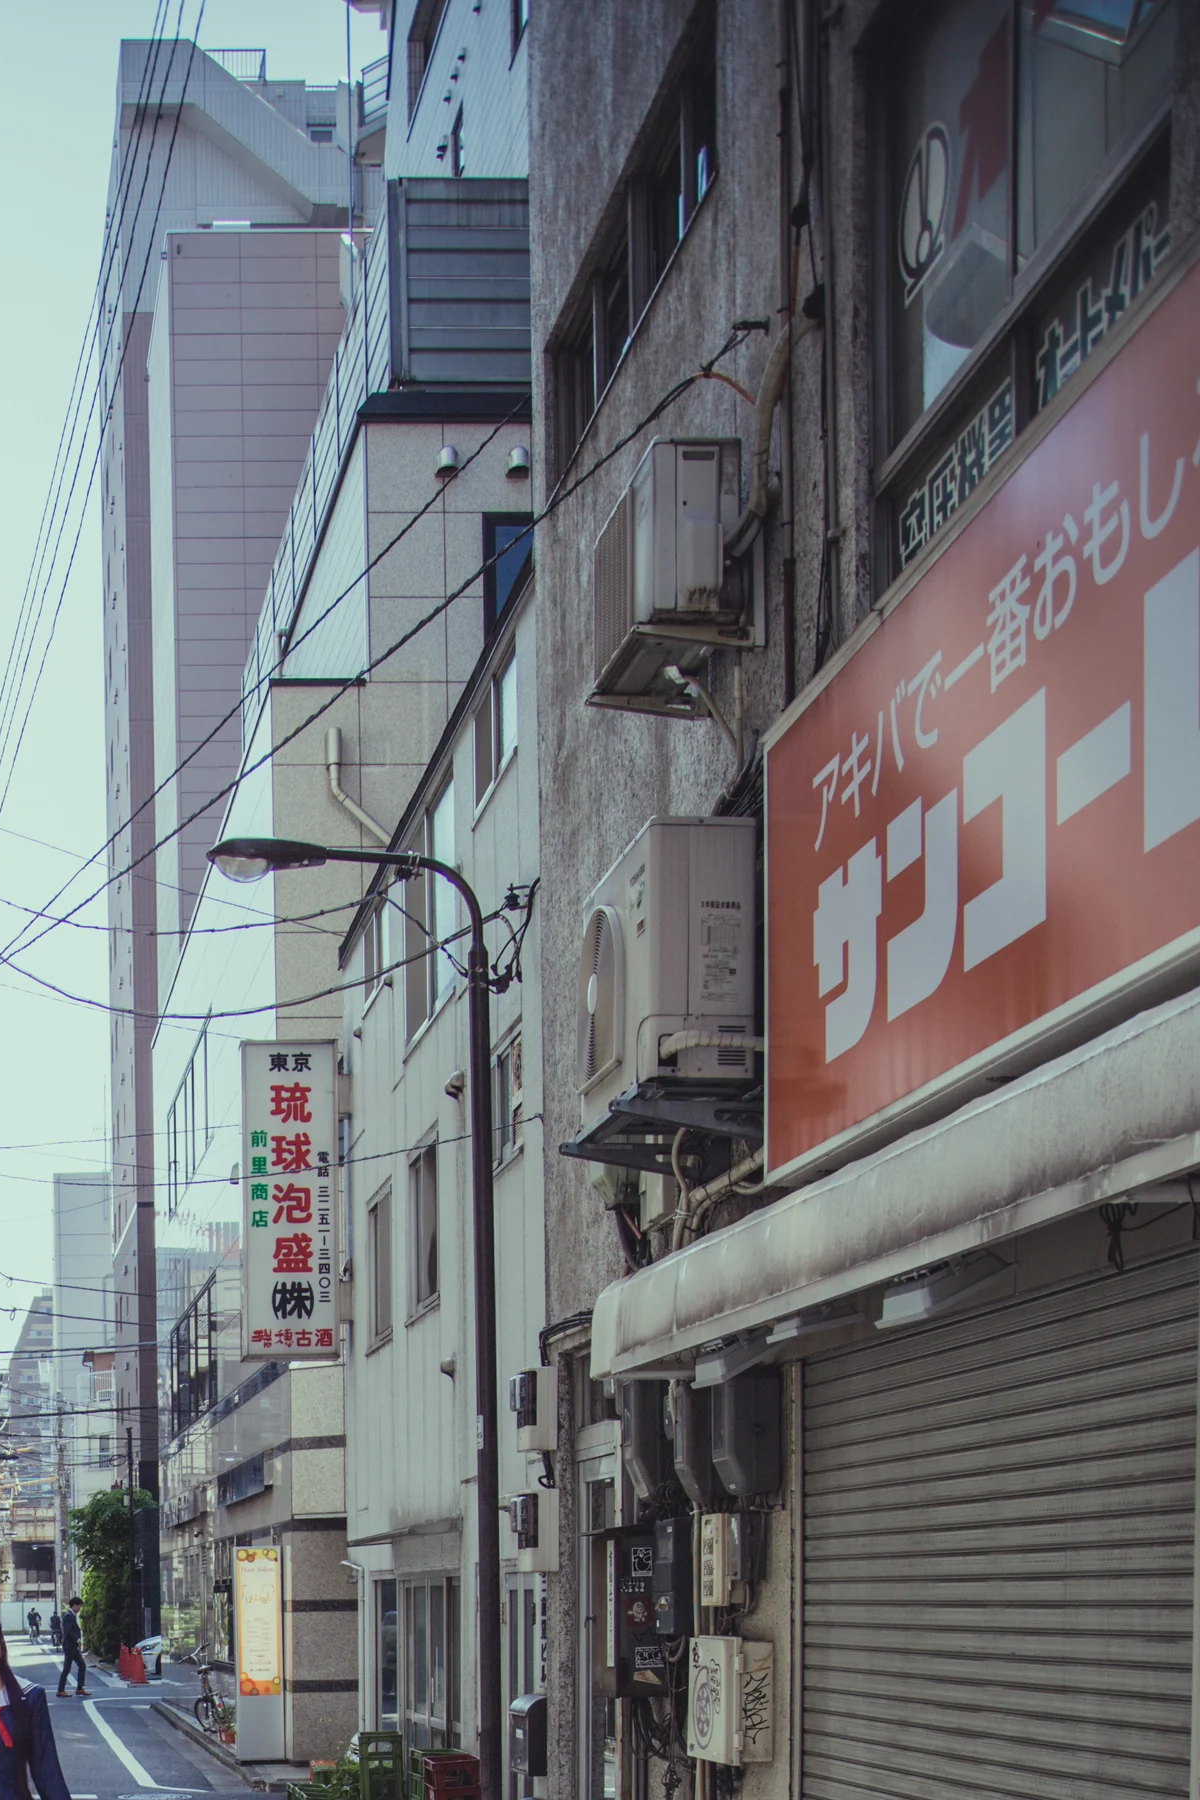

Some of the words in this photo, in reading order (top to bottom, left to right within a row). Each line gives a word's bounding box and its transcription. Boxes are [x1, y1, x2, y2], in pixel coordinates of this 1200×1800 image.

[812, 376, 1200, 852] アキバで一番おもし
[268, 1051, 312, 1073] 東京
[249, 1129, 270, 1229] 前里商店
[316, 1150, 331, 1179] 電話
[257, 1565, 275, 1573] Salon
